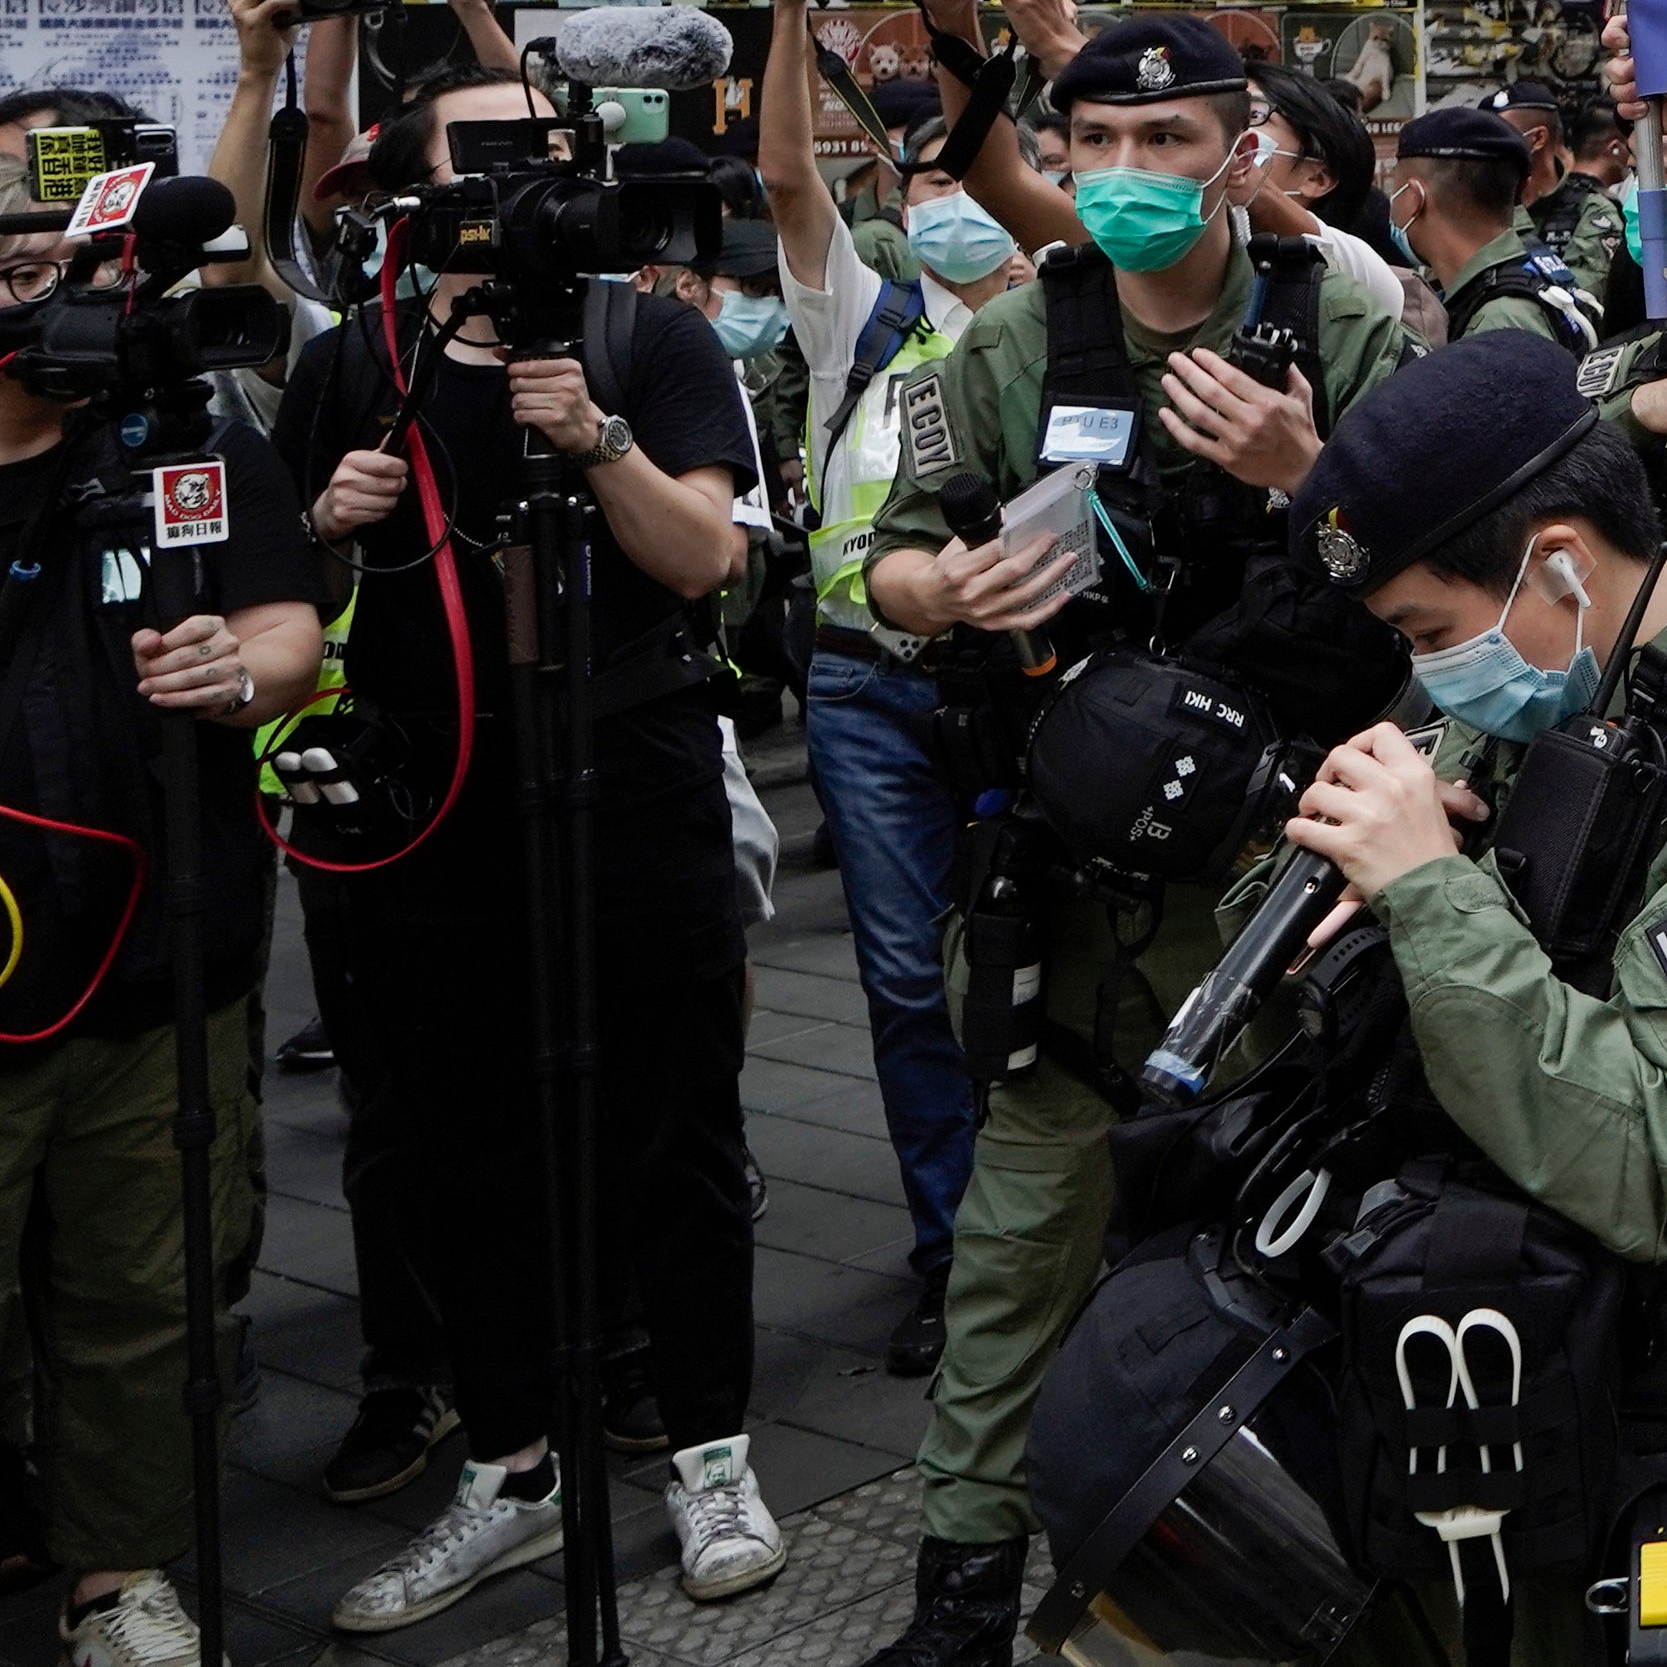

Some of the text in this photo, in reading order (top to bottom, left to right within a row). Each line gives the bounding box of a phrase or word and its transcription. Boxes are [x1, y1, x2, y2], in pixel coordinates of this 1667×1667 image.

[907, 381, 954, 467] E COY
[1099, 416, 1119, 430] E3
[1183, 689, 1213, 712] HKI
